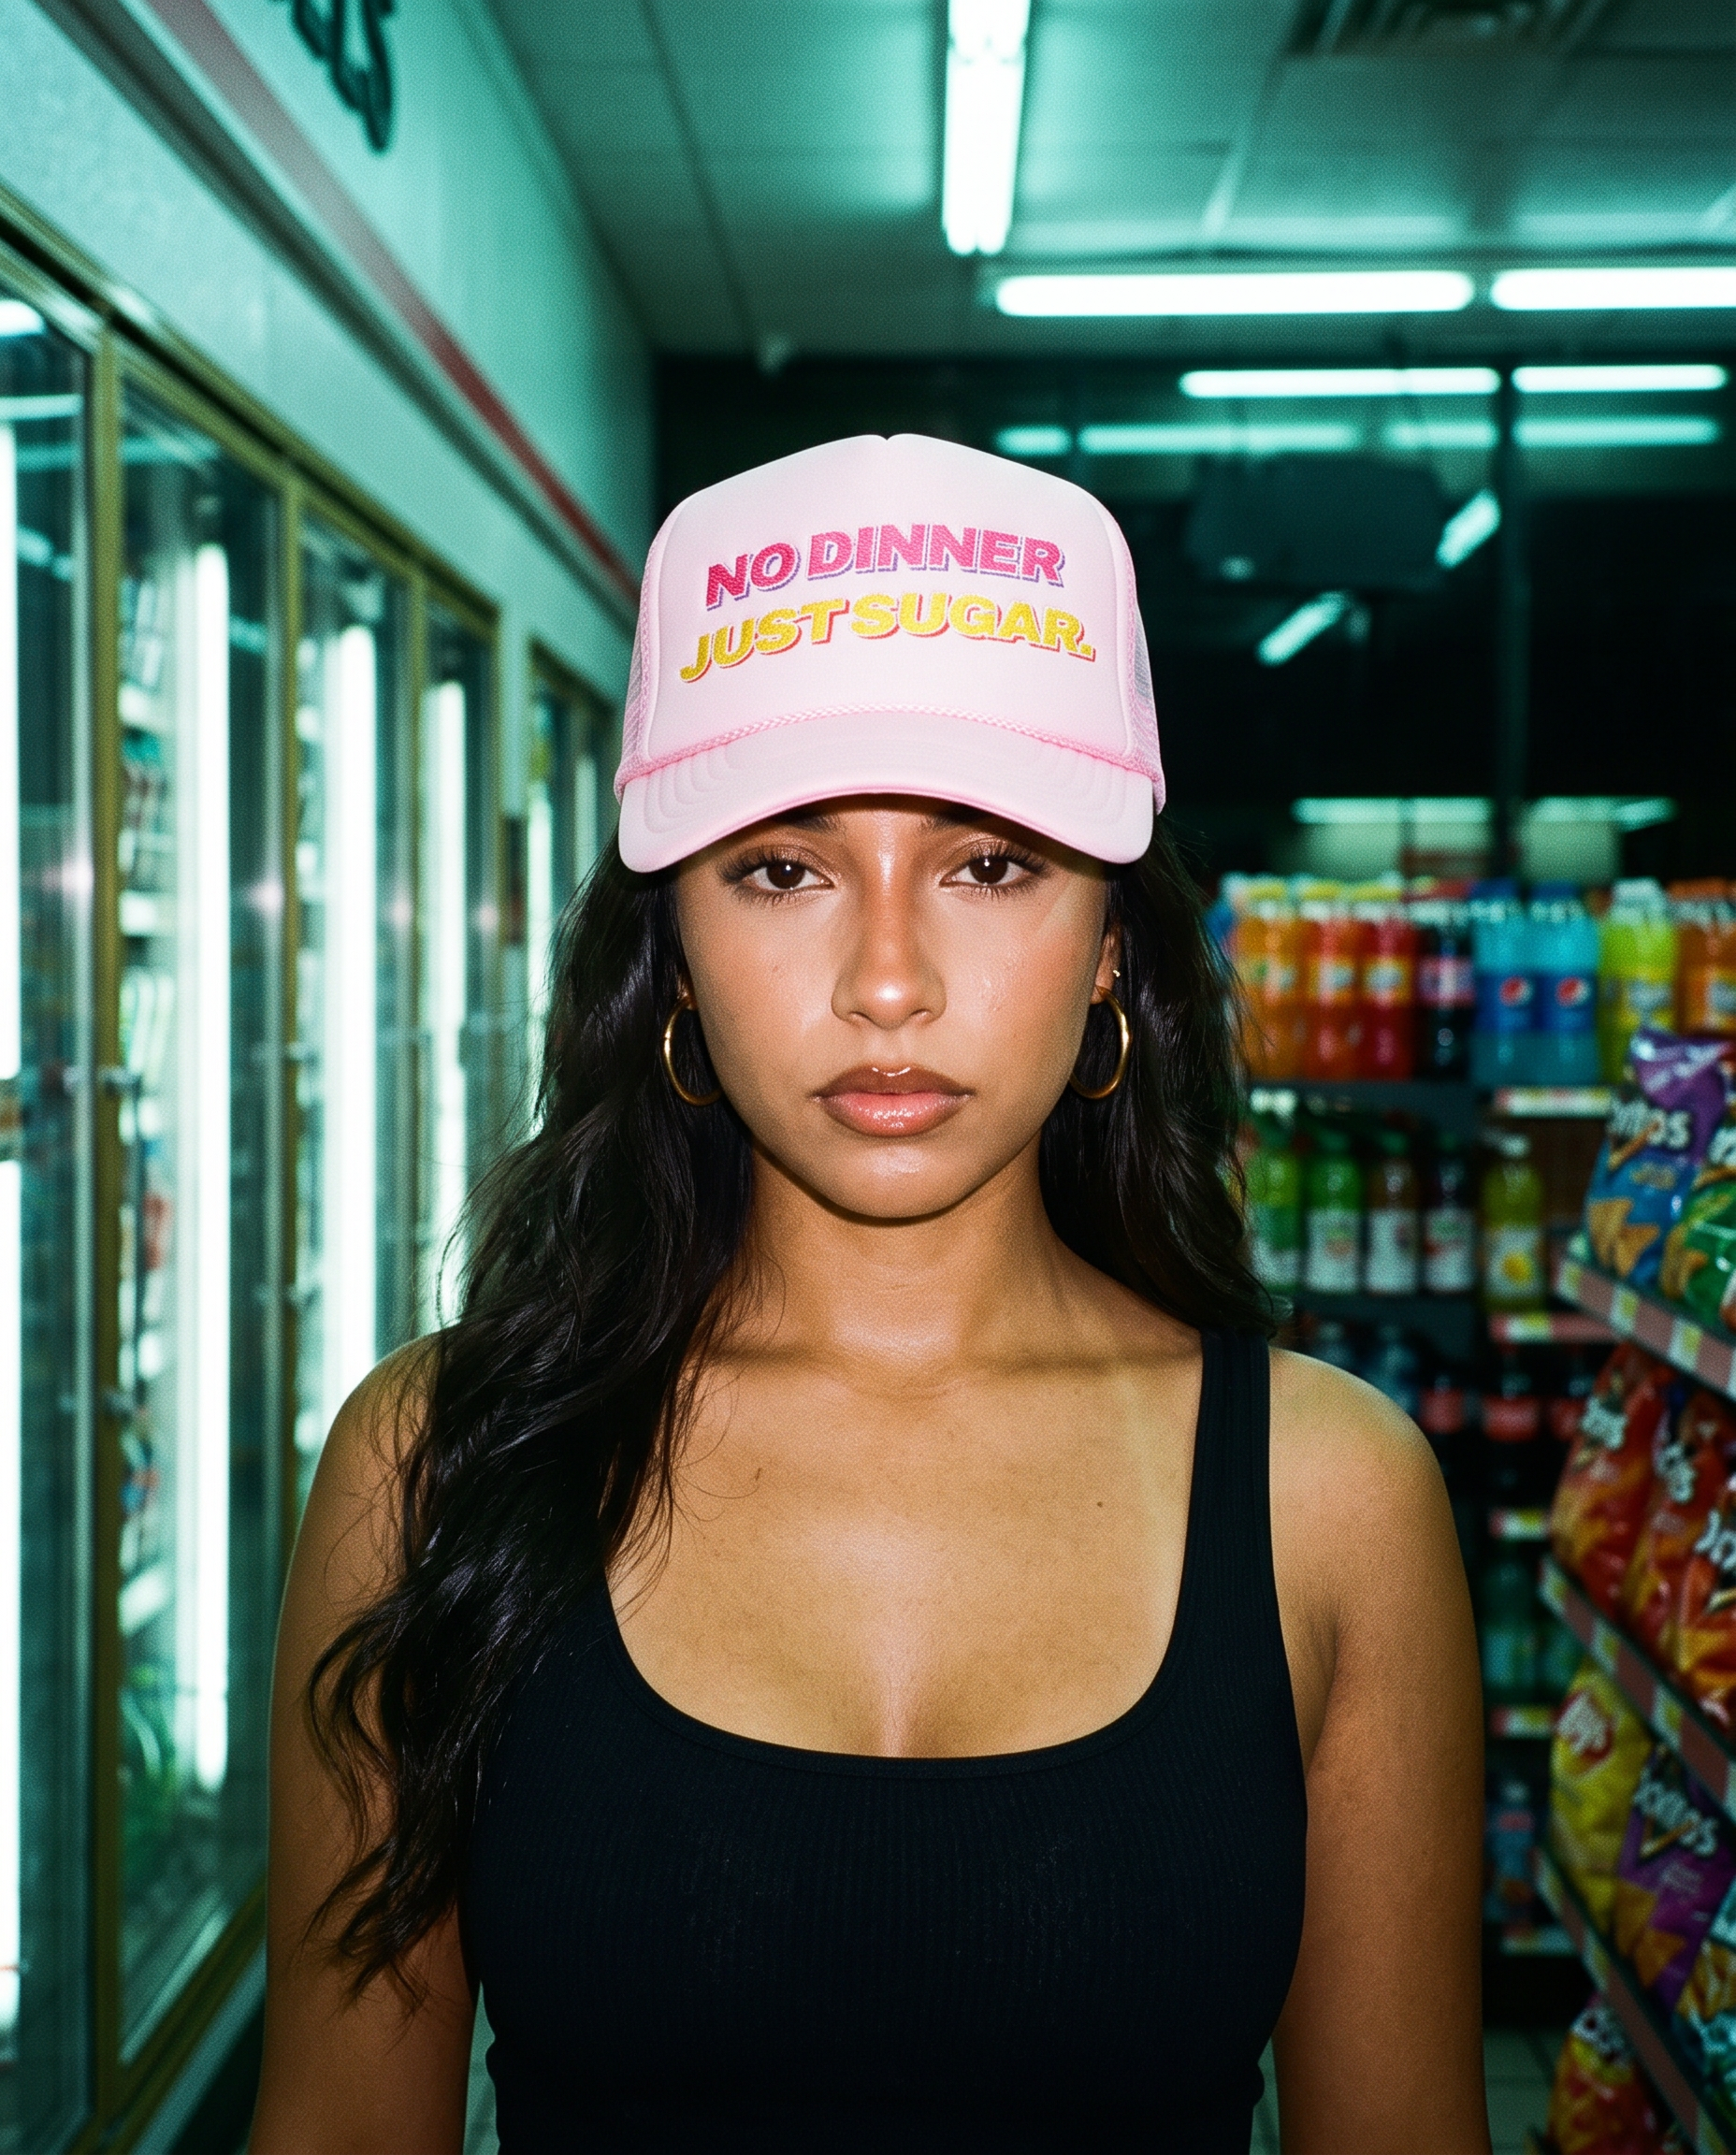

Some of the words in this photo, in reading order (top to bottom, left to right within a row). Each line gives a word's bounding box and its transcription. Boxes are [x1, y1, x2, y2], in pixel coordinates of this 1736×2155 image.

[706, 542, 802, 611] NO
[807, 524, 1065, 587] DINNER
[680, 599, 849, 683] JUST
[850, 592, 1096, 662] SUGAR.
